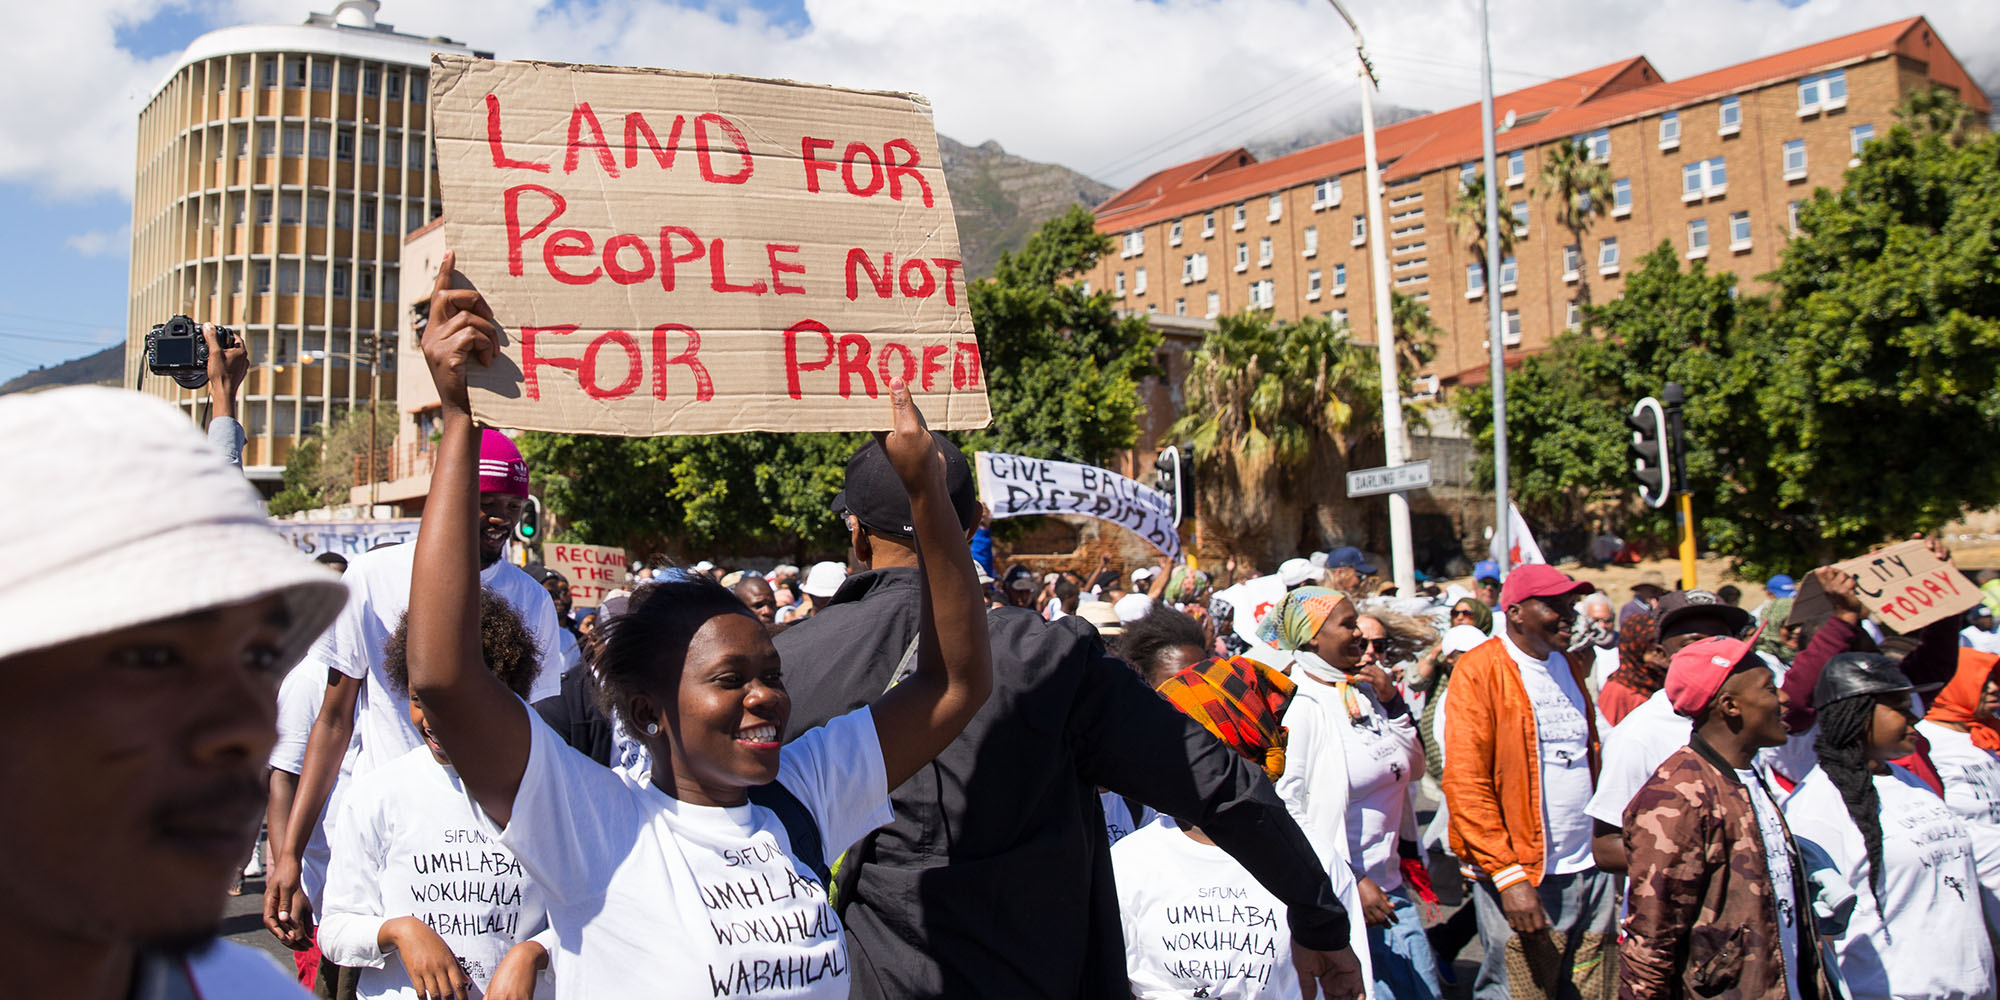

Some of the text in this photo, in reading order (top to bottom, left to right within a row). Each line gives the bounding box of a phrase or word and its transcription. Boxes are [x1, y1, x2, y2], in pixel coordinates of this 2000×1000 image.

[485, 94, 934, 208] LAND FOR
[845, 247, 963, 306] NOT
[520, 318, 980, 402] FOR PROFIT
[1355, 471, 1395, 490] DARLING
[572, 566, 615, 582] THE
[569, 585, 625, 600] CIT
[1881, 571, 1960, 621] TODAY
[413, 850, 523, 878] UMHLABA
[724, 841, 783, 867] SIFUN
[410, 880, 522, 906] WOKUHLALA
[1198, 887, 1248, 899] SIFUNA
[412, 912, 519, 939] ABAHLALI!
[1167, 904, 1278, 932] UMHLABA
[1162, 930, 1276, 958] WOKUHLALA
[708, 944, 848, 998] WABAHLALI
